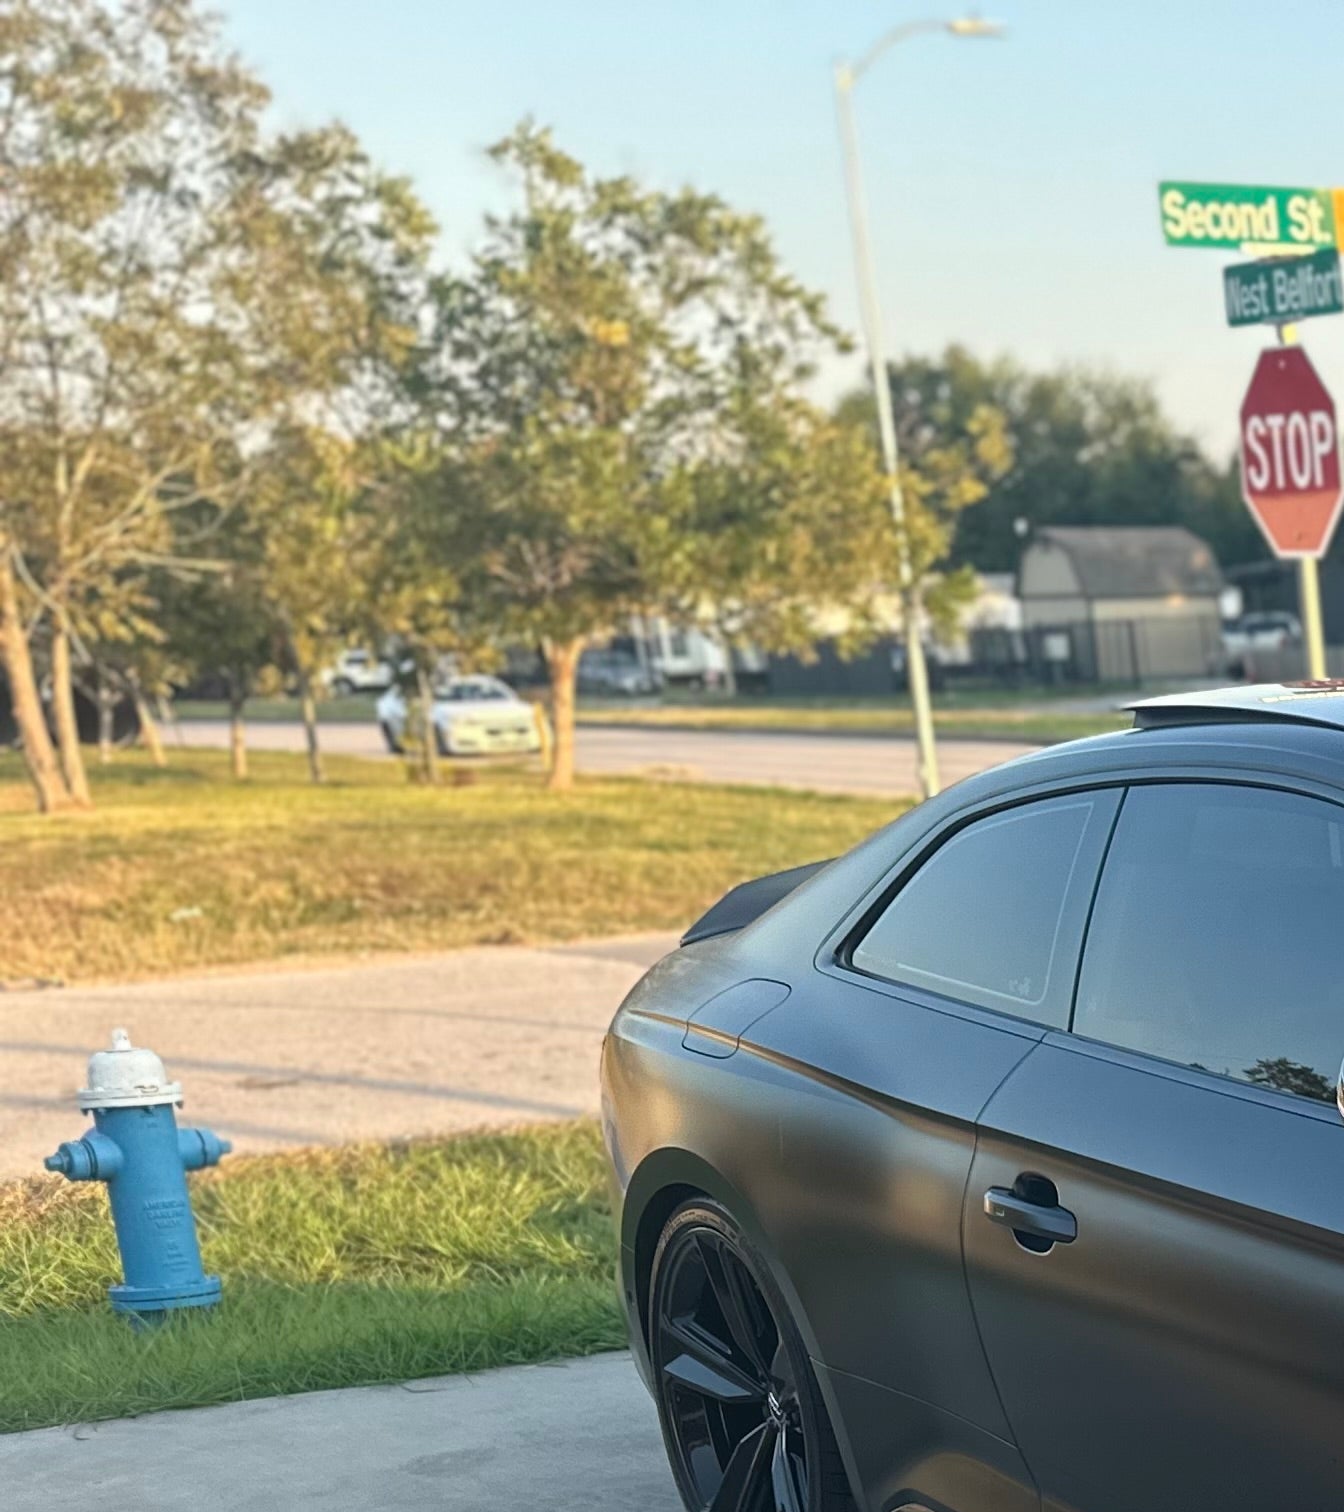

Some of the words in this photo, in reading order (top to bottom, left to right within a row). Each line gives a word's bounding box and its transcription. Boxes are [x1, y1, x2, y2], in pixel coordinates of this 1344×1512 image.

[1163, 189, 1279, 240] Second
[1286, 195, 1333, 243] St.
[1245, 411, 1334, 491] STOP
